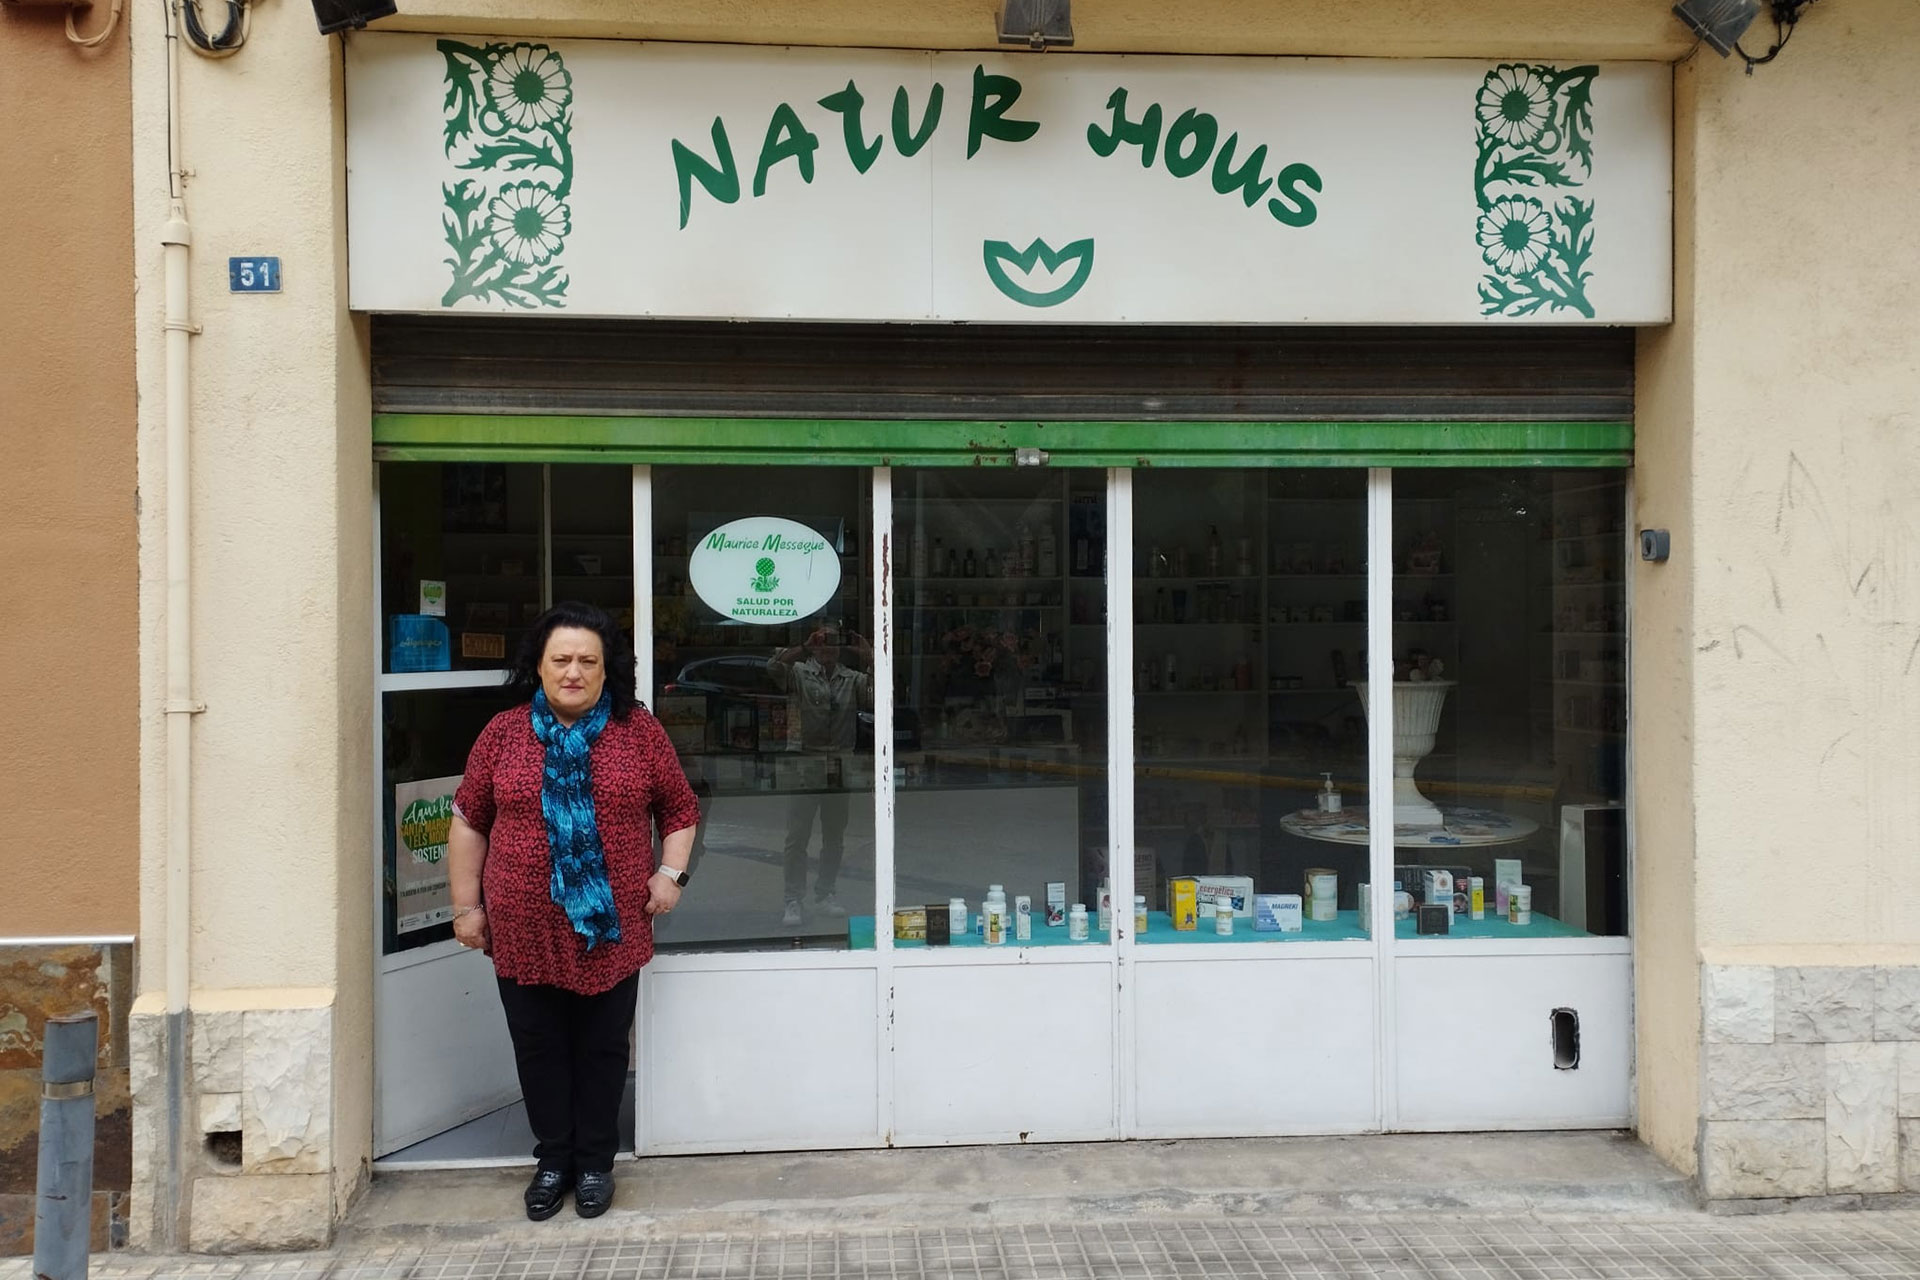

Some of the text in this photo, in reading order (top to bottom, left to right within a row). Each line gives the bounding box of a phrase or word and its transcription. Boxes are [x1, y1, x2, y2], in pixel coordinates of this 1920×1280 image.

[671, 64, 1323, 230] NATUR HOUS
[241, 262, 270, 287] 51
[706, 532, 759, 552] Maurice
[736, 597, 794, 607] SALUD POR
[731, 608, 798, 617] NATURALEZA
